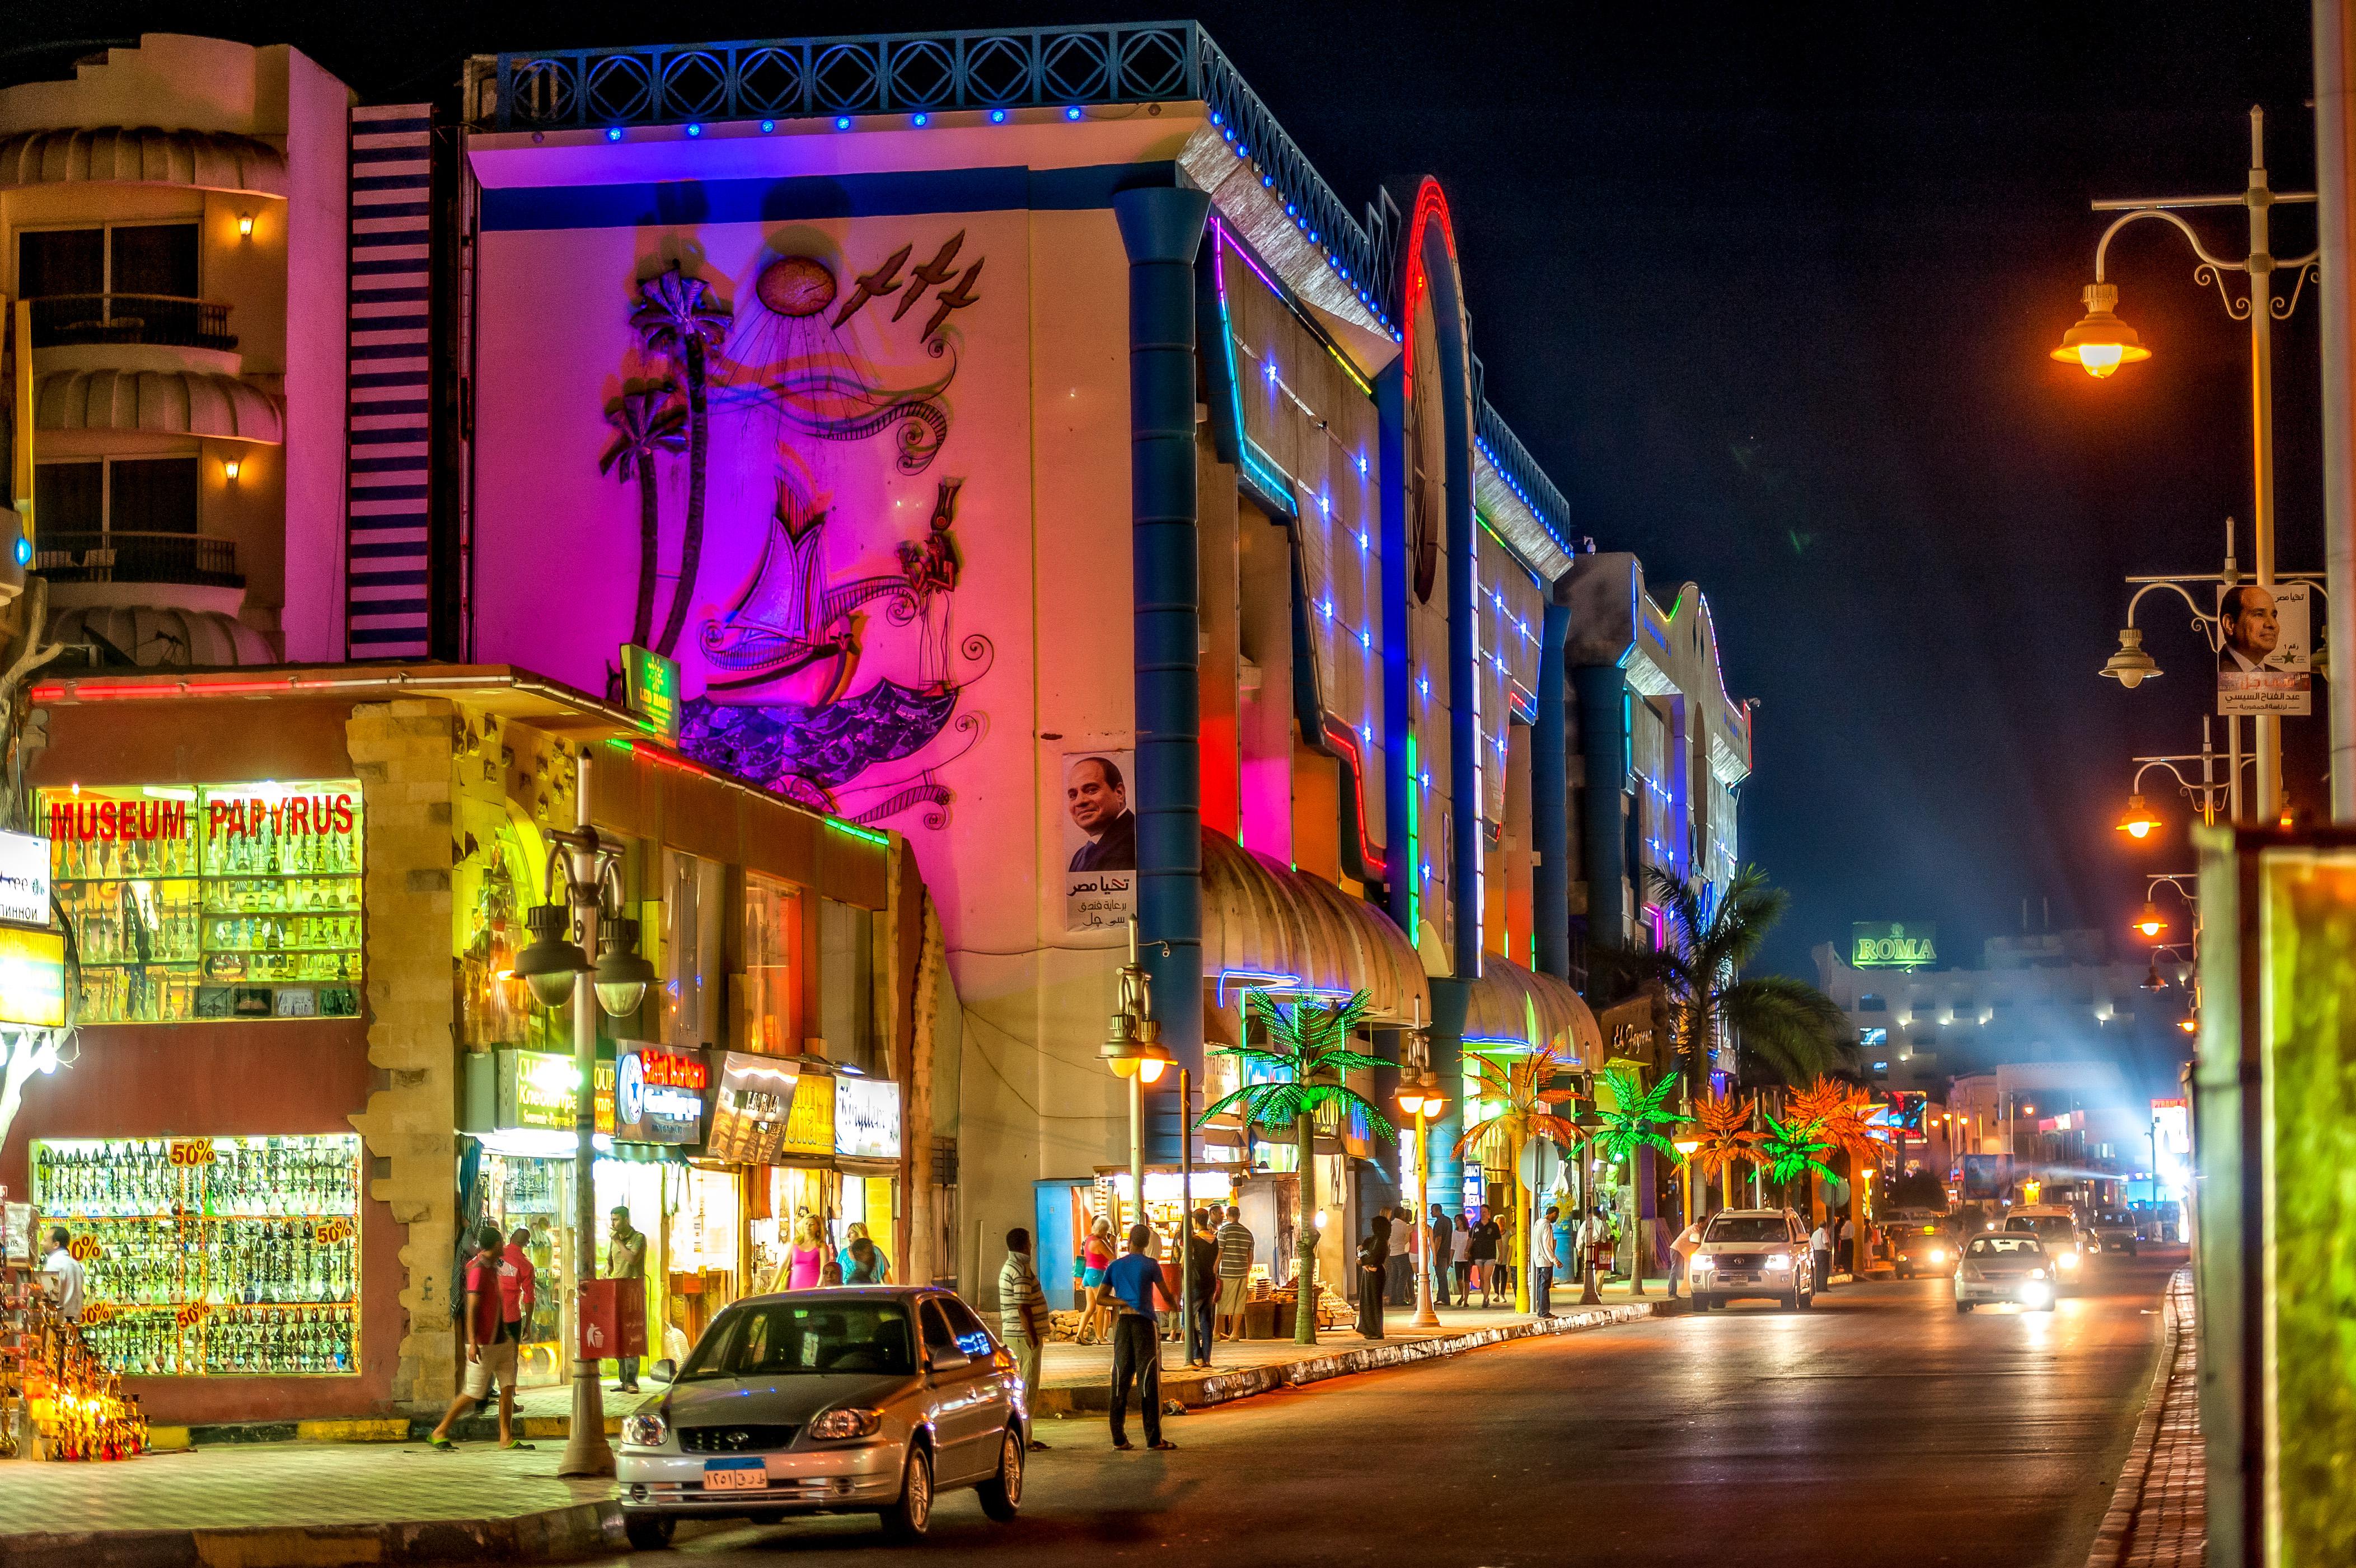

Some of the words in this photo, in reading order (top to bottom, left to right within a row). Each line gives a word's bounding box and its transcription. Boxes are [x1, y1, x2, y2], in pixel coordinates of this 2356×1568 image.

[2225, 692, 2260, 703] السيسي
[2261, 692, 2284, 701] الفتاح
[50, 800, 185, 842] MUSEUM
[209, 794, 353, 839] PAPYRUS
[1066, 883, 1098, 896] مصر
[1100, 876, 1130, 895] تحيا
[1078, 900, 1102, 913] فندق
[1104, 899, 1126, 912] برعاية
[1858, 938, 1936, 960] ROMA
[1204, 1055, 1215, 1075] anta
[594, 1067, 615, 1091] OUP
[786, 1106, 817, 1145] ona
[172, 1140, 215, 1166] 50%
[318, 1220, 352, 1244] 50%
[68, 1236, 100, 1261] 0%
[177, 1298, 210, 1329] 50%
